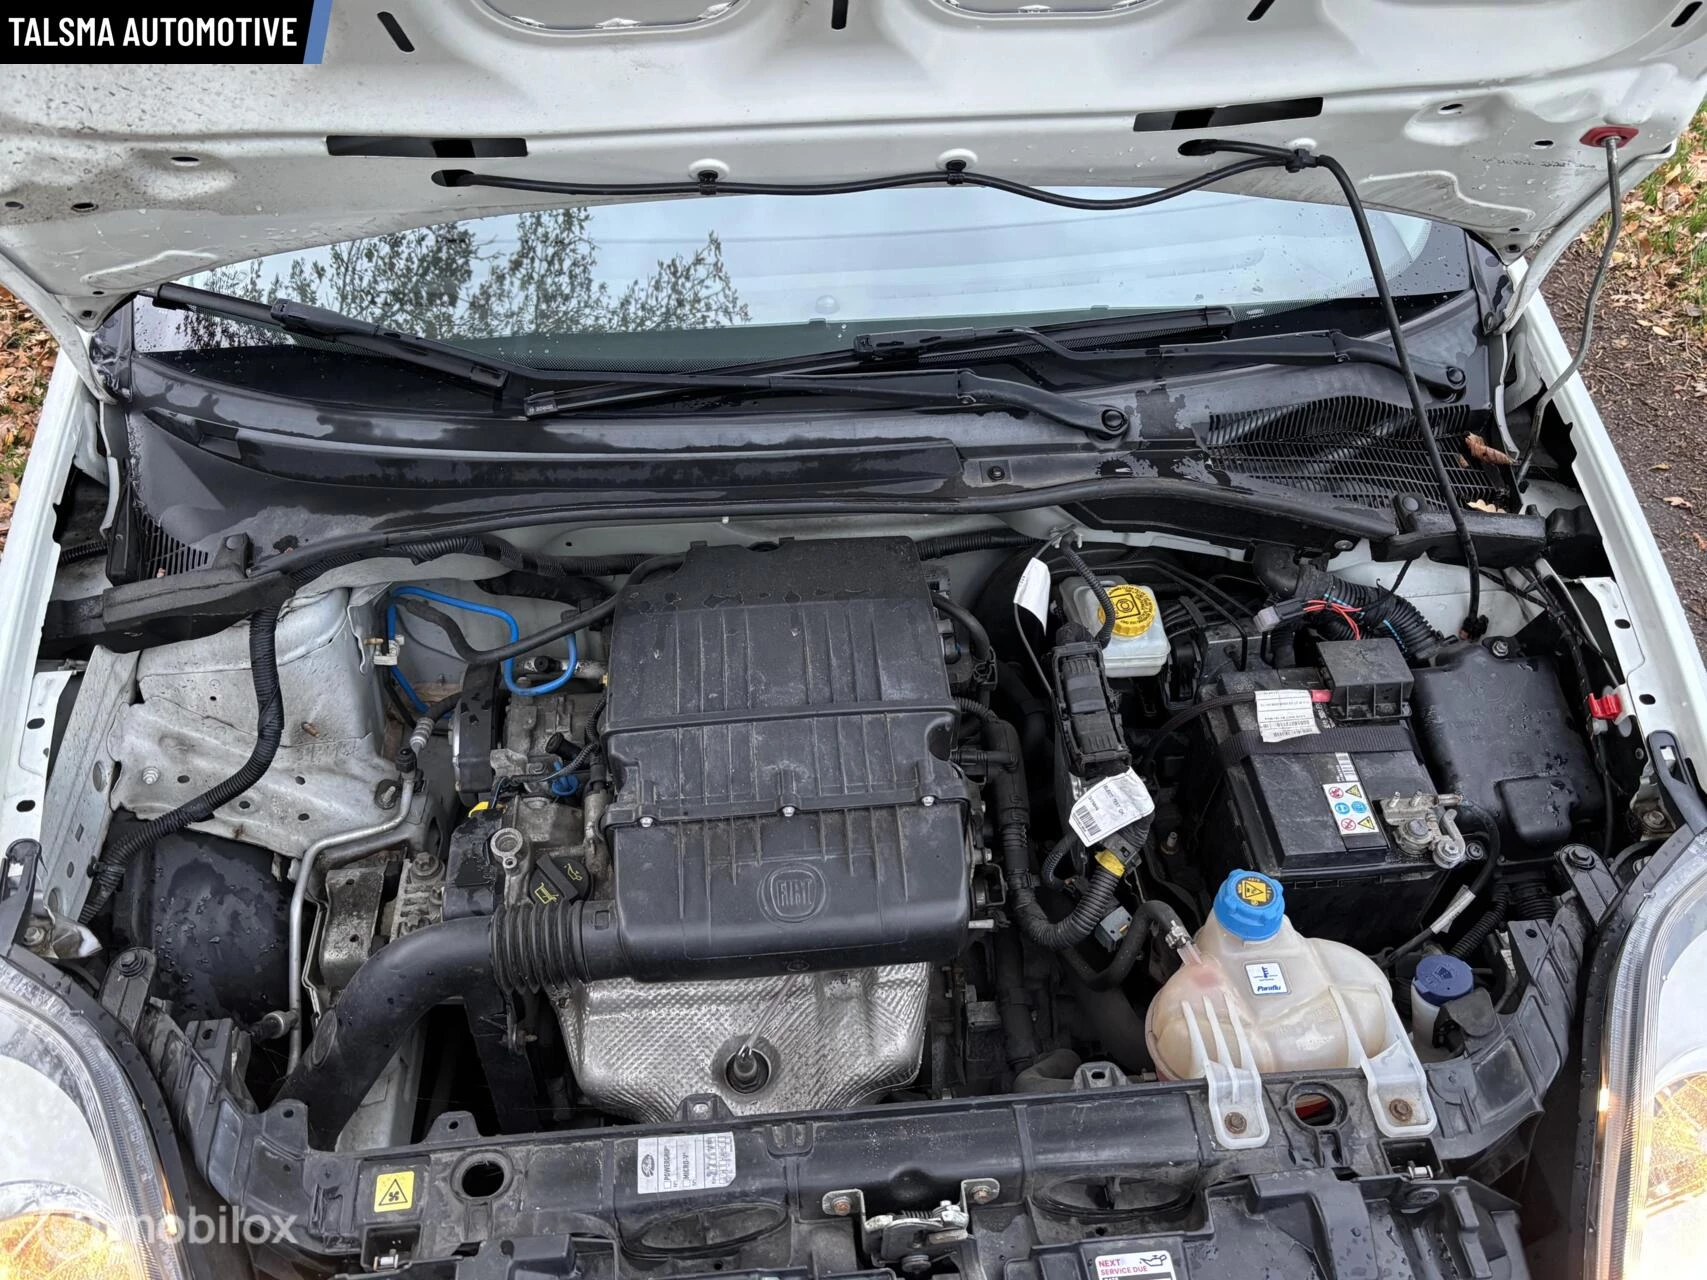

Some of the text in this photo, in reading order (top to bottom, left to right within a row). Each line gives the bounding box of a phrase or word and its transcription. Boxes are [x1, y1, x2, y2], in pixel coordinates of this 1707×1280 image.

[775, 879, 813, 907] FIAT
[1098, 1259, 1121, 1268] NEXT
[1100, 1265, 1148, 1276] SERVICE DUE
